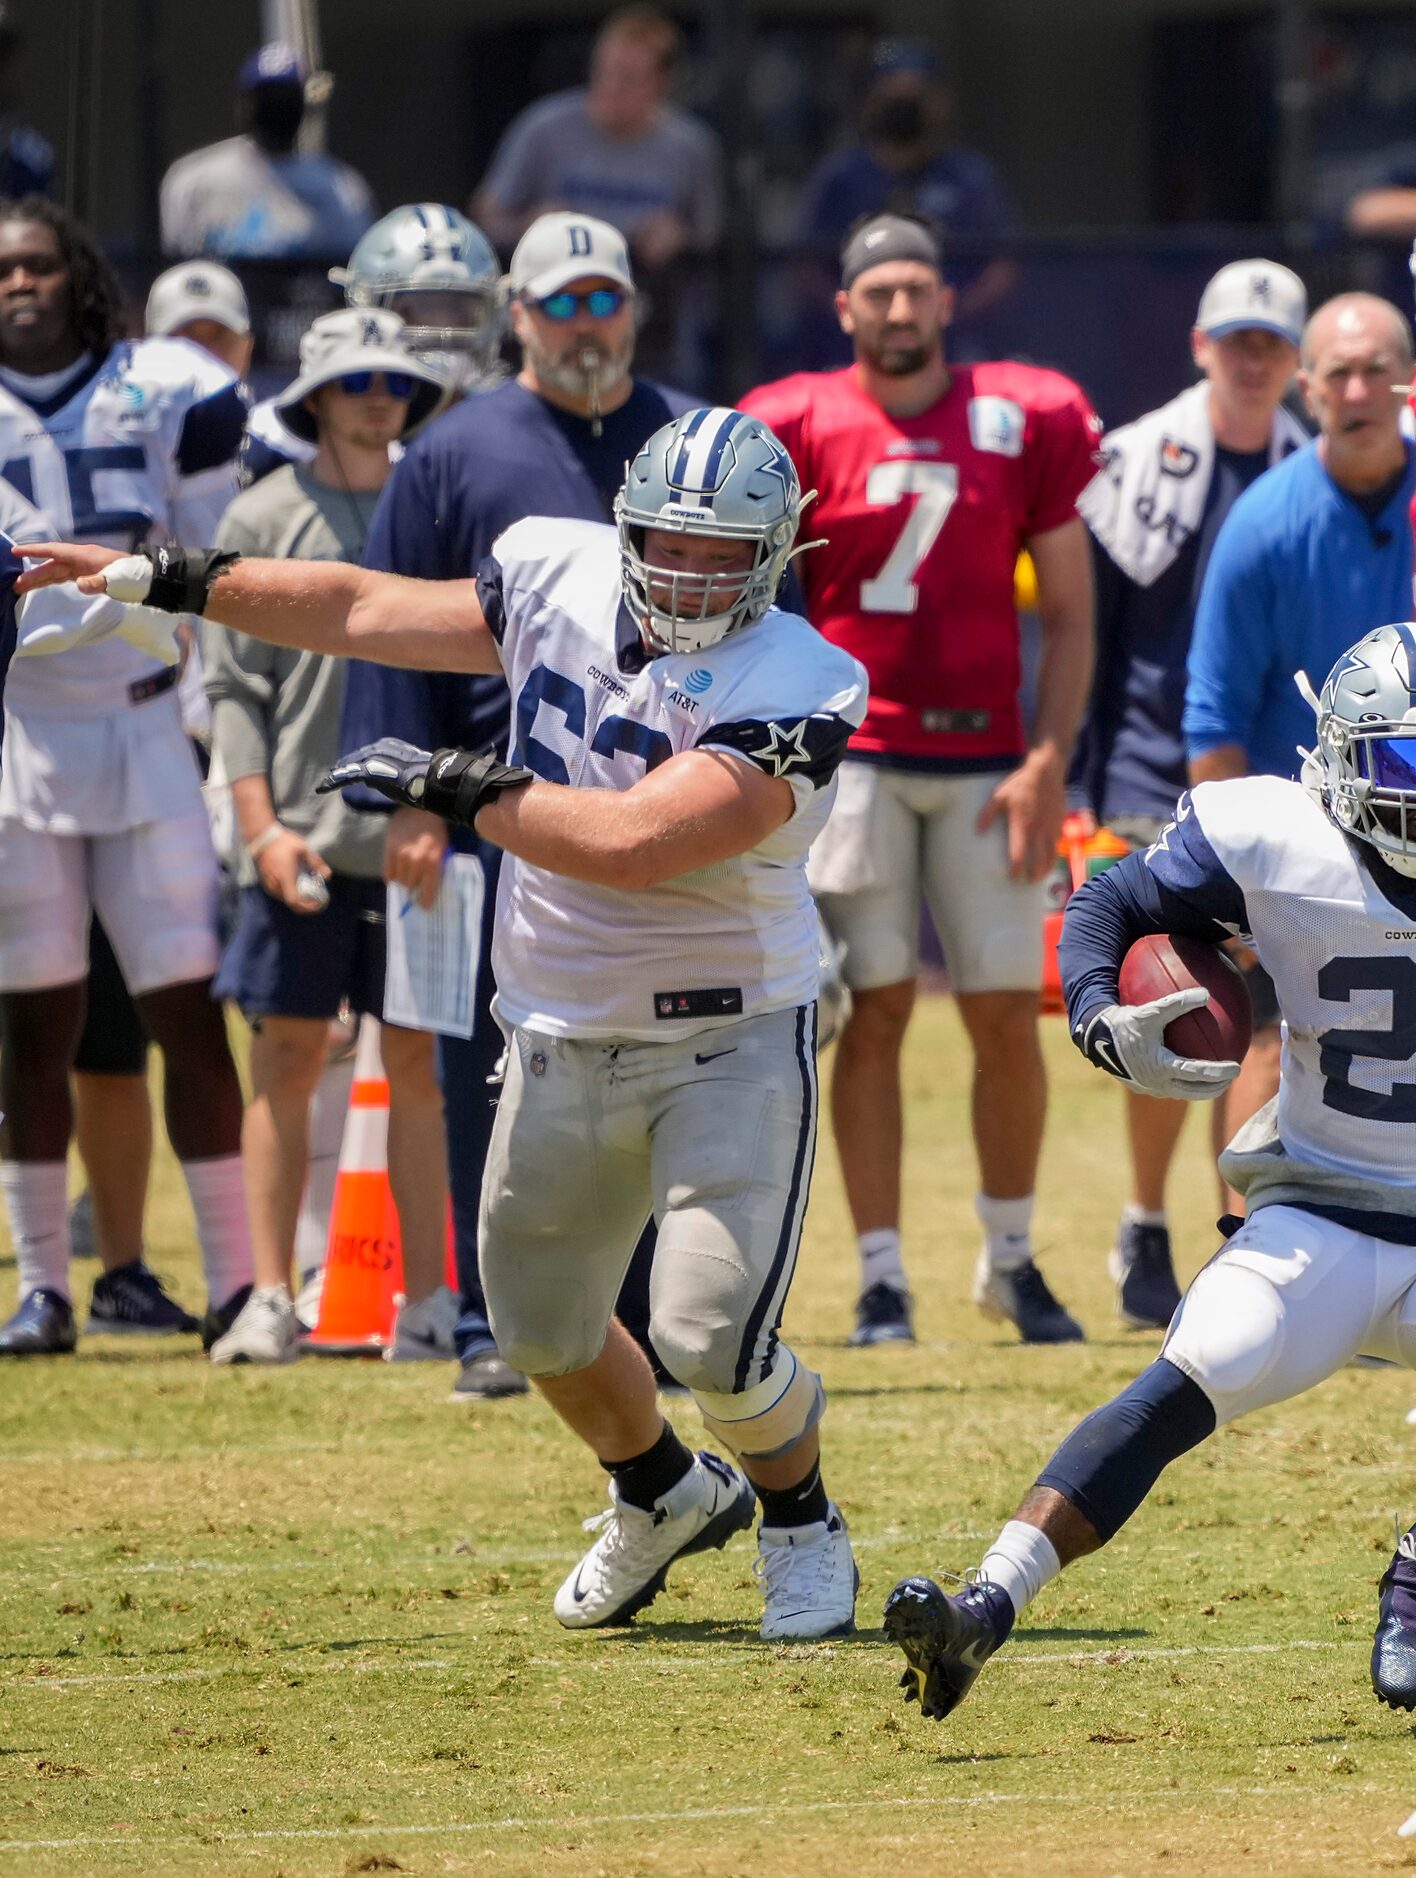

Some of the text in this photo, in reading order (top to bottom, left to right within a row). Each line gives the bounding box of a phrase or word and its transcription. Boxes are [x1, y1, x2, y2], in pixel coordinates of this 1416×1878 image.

[569, 227, 592, 256] D
[860, 459, 960, 615] 7
[668, 690, 700, 713] AT&T
